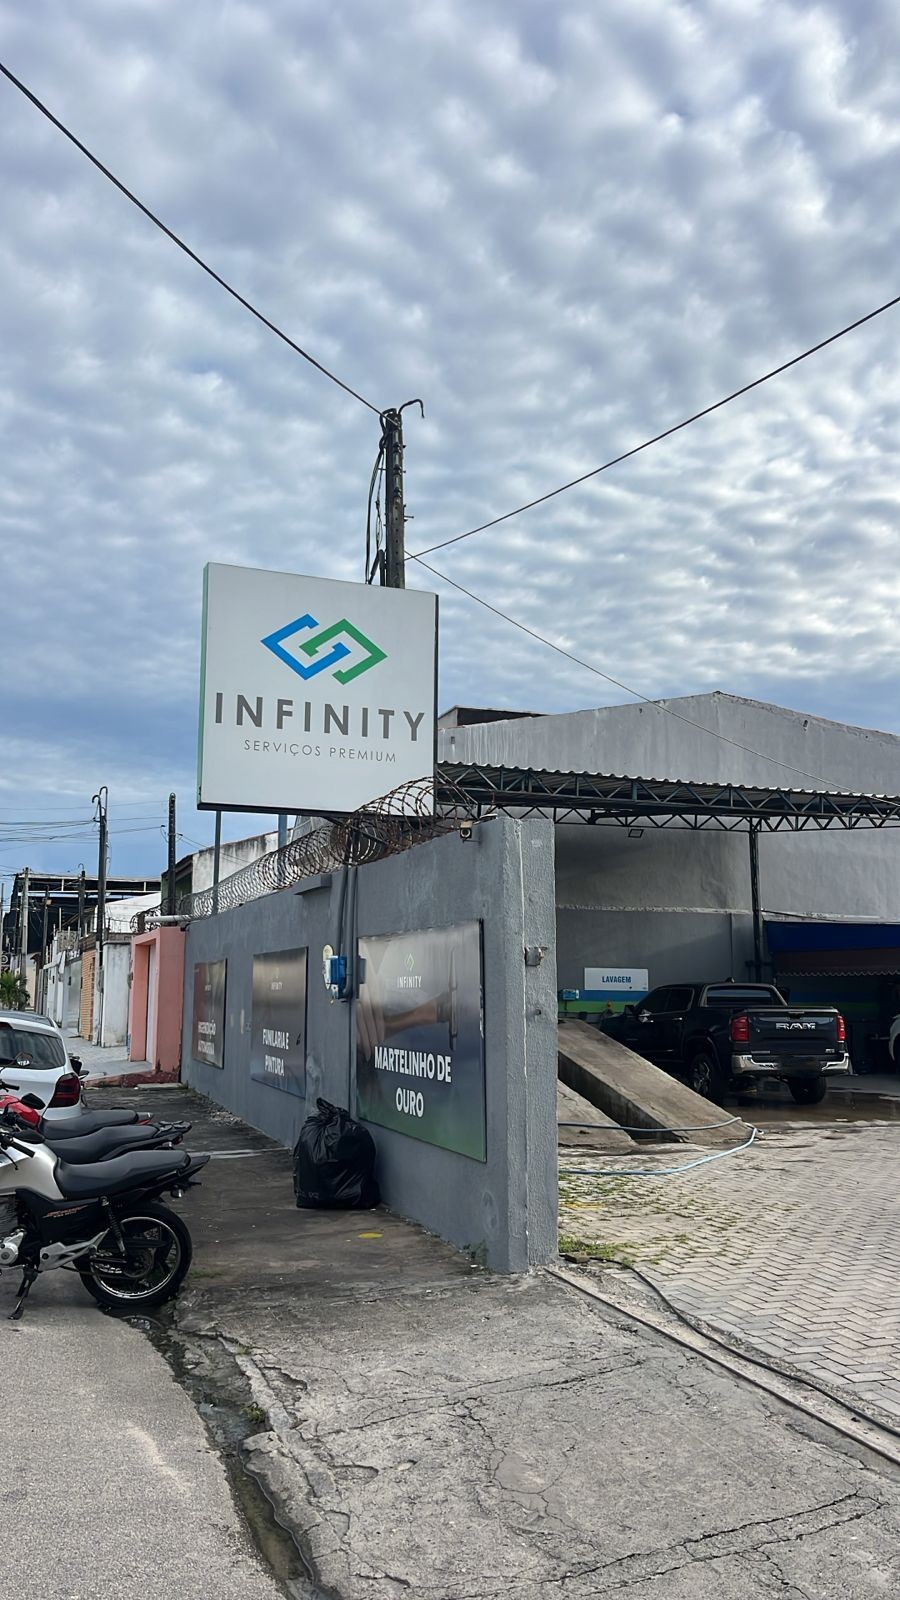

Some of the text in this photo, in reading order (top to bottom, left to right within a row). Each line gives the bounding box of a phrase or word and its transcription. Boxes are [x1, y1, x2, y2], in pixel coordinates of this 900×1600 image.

[215, 692, 425, 741] INFINITY
[244, 739, 396, 763] SERVIÇOS PREMIUM
[397, 975, 422, 989] INFINITY
[601, 975, 632, 984] LAVAGEM
[776, 1022, 816, 1030] RAM
[374, 1046, 452, 1083] MARTELINHO DE
[395, 1087, 424, 1118] OURO
